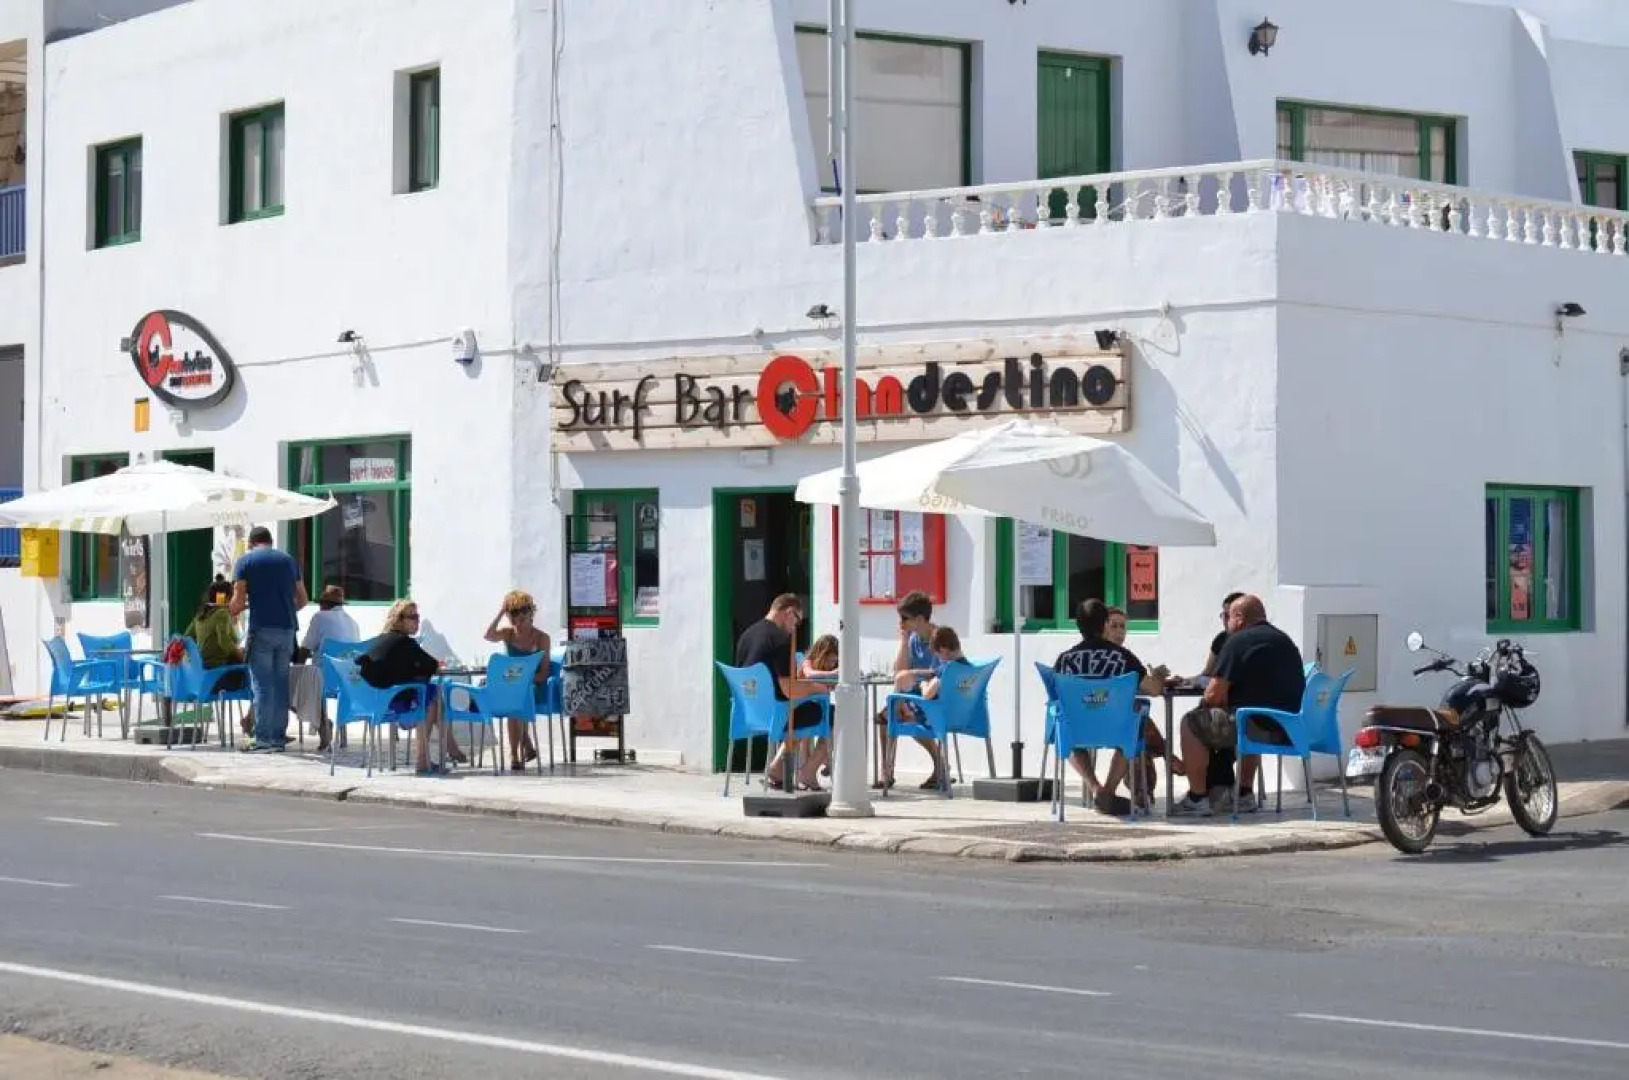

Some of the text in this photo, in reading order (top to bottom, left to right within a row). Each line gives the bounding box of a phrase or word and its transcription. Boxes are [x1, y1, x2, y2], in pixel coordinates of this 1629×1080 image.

[558, 373, 656, 440] Surf
[675, 373, 750, 429] Bar
[1041, 505, 1090, 530] FRIGO
[1061, 648, 1126, 677] KISS
